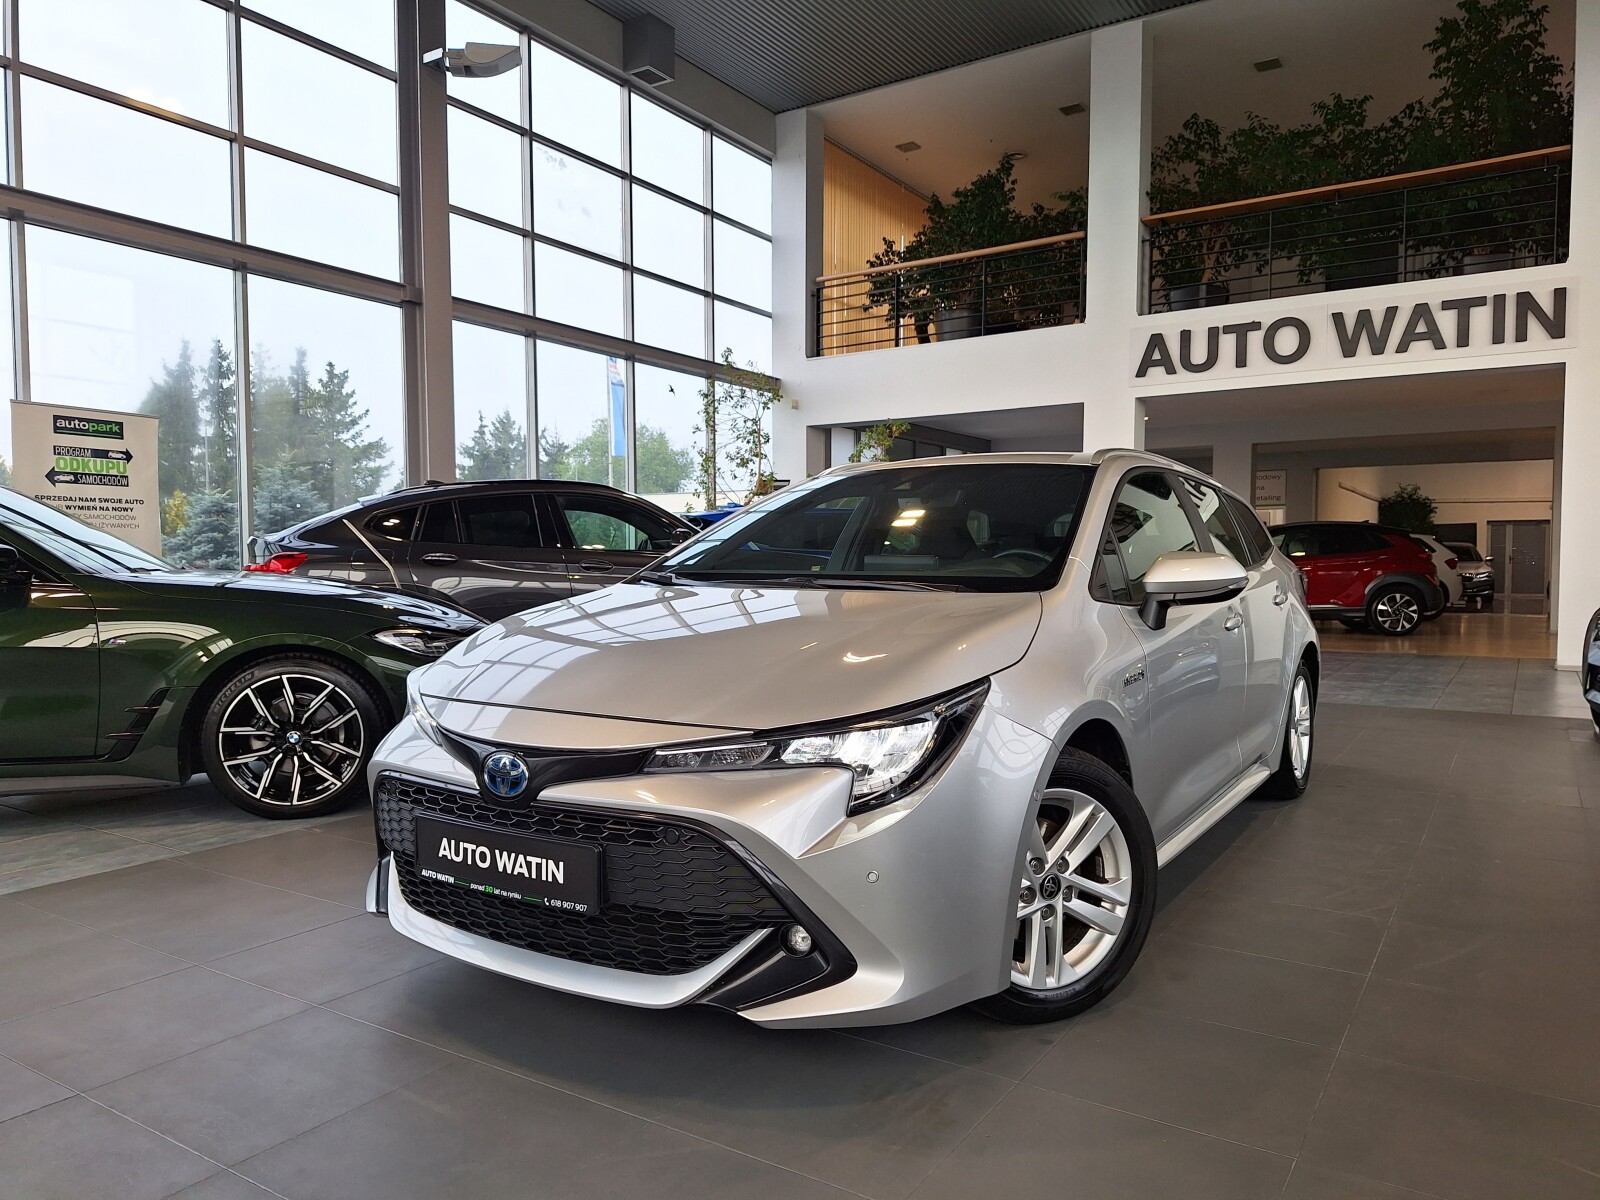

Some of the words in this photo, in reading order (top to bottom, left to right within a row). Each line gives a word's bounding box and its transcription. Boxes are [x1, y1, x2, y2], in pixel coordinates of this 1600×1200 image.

[1135, 316, 1311, 378] AUTO
[1331, 287, 1567, 358] WATIN
[56, 418, 121, 433] autopark
[55, 446, 92, 457] PROGRAM
[55, 457, 128, 475] ODKUPU
[77, 474, 128, 486] SAMOCHODÓW
[34, 494, 77, 503] SPRZEDAJ
[83, 513, 137, 521] SAMOCHODÓW
[213, 673, 252, 713] MICHELIN
[438, 837, 491, 869] AUTO
[495, 849, 564, 884] WATIN
[421, 869, 437, 879] AUTO
[436, 873, 455, 884] WATIN
[470, 883, 485, 891] ponad
[485, 885, 493, 893] 30
[507, 891, 522, 899] rynku
[550, 899, 562, 907] 618
[562, 901, 574, 909] 907
[574, 903, 588, 912] 907
